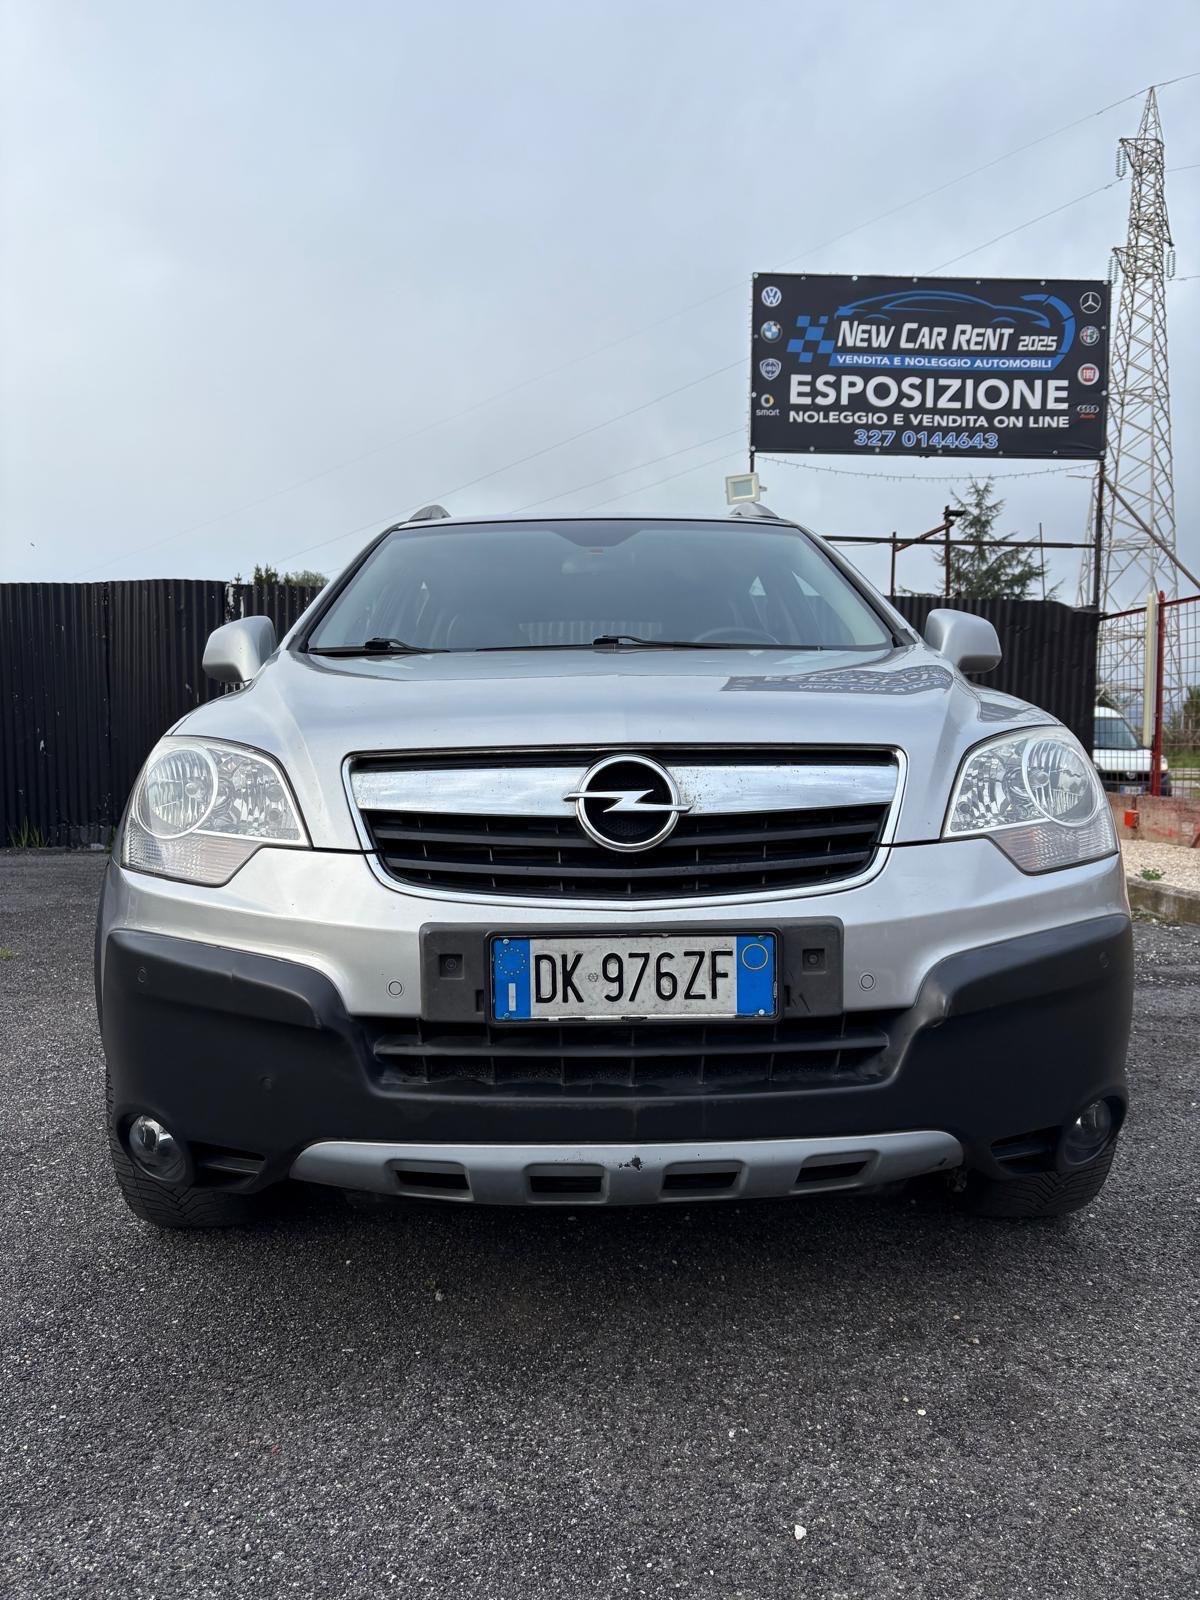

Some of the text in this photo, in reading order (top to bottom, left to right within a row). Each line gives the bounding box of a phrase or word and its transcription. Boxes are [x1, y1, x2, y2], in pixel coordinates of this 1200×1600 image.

[1017, 335, 1058, 352] 2025
[837, 354, 1052, 369] VENDITA E NOLEGGIO AUTOMOBILI
[789, 374, 1069, 410] ESPOSIZIONE
[755, 407, 780, 417] smart
[789, 410, 1070, 429] NOLEGGIO E VENDITA ON LINE
[854, 428, 999, 449] 327 0144643
[534, 950, 734, 1004] DK 976ZF
